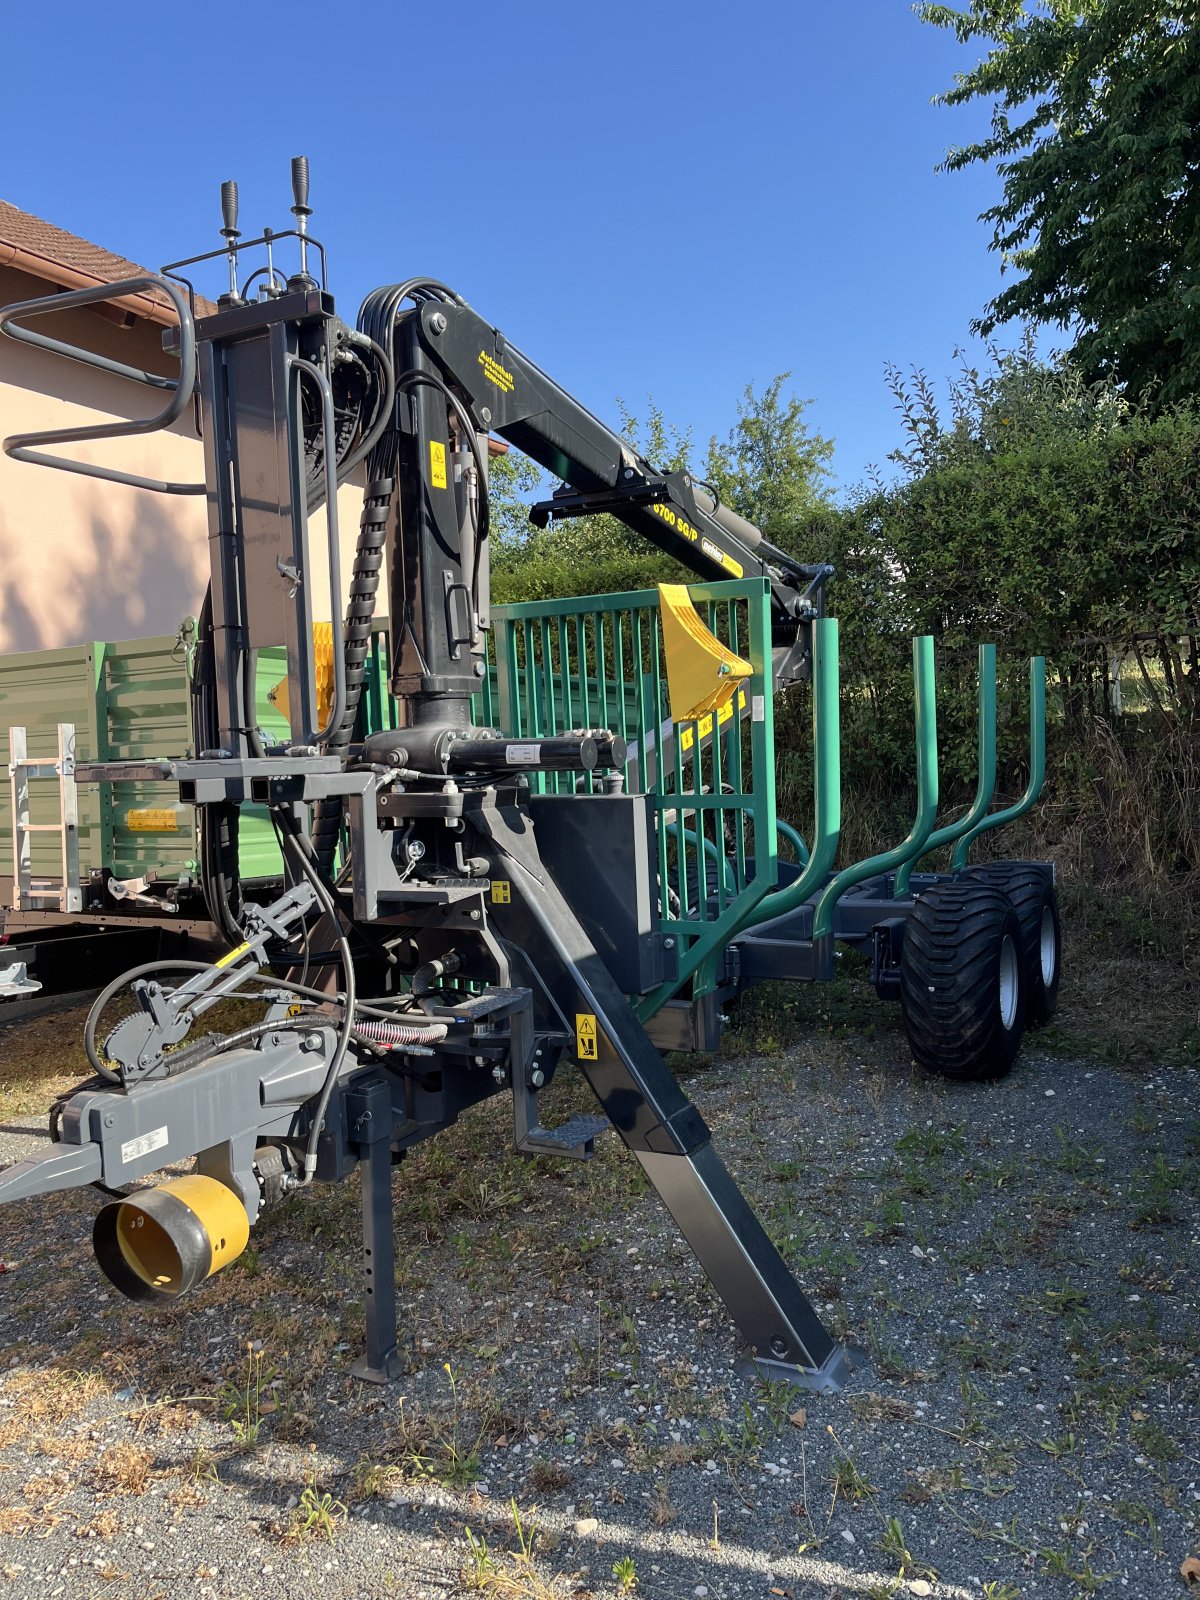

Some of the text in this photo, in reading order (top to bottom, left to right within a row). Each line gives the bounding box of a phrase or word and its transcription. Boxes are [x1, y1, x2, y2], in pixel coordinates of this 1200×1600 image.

[480, 350, 513, 383] Aufenthalt
[484, 369, 508, 393] VERBOTEN
[677, 517, 698, 542] SG/P
